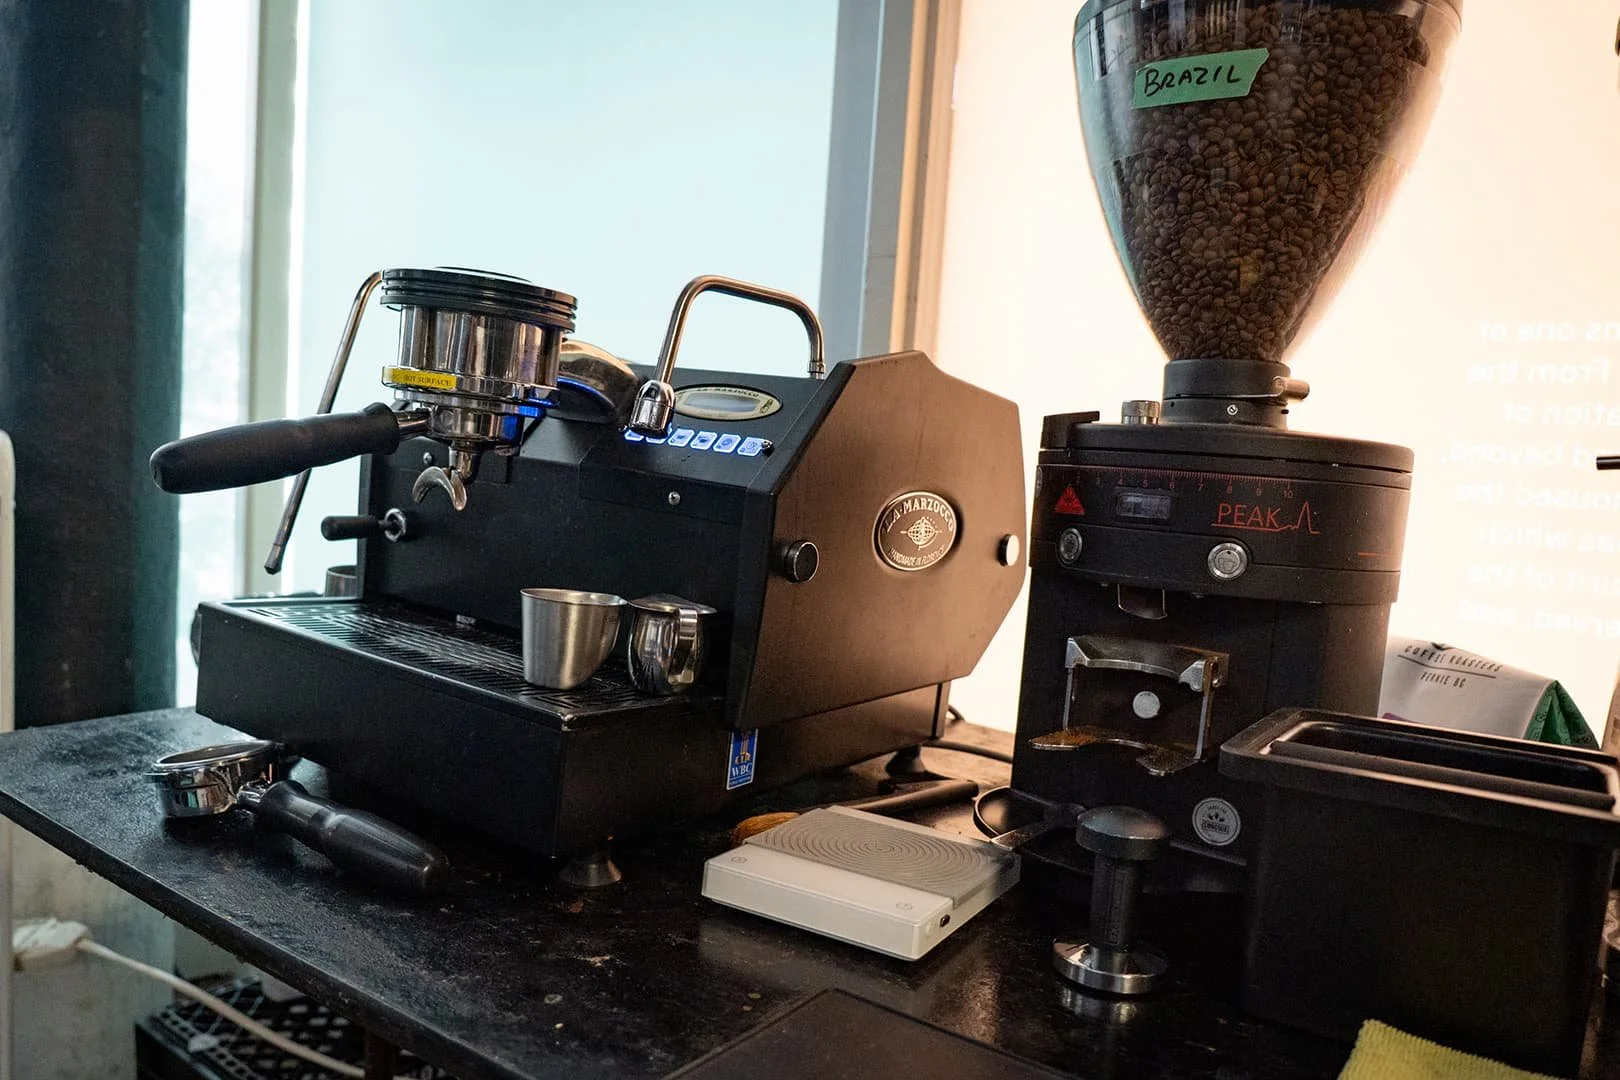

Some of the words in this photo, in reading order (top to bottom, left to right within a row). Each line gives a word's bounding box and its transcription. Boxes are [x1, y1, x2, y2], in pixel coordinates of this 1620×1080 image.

[1144, 65, 1241, 96] BRAZIL
[903, 497, 954, 532] MARZOCCO
[1217, 502, 1281, 528] PEAK
[1404, 645, 1446, 663] COFFEE
[1449, 655, 1503, 673] ROASTERS
[731, 762, 753, 777] WBC
